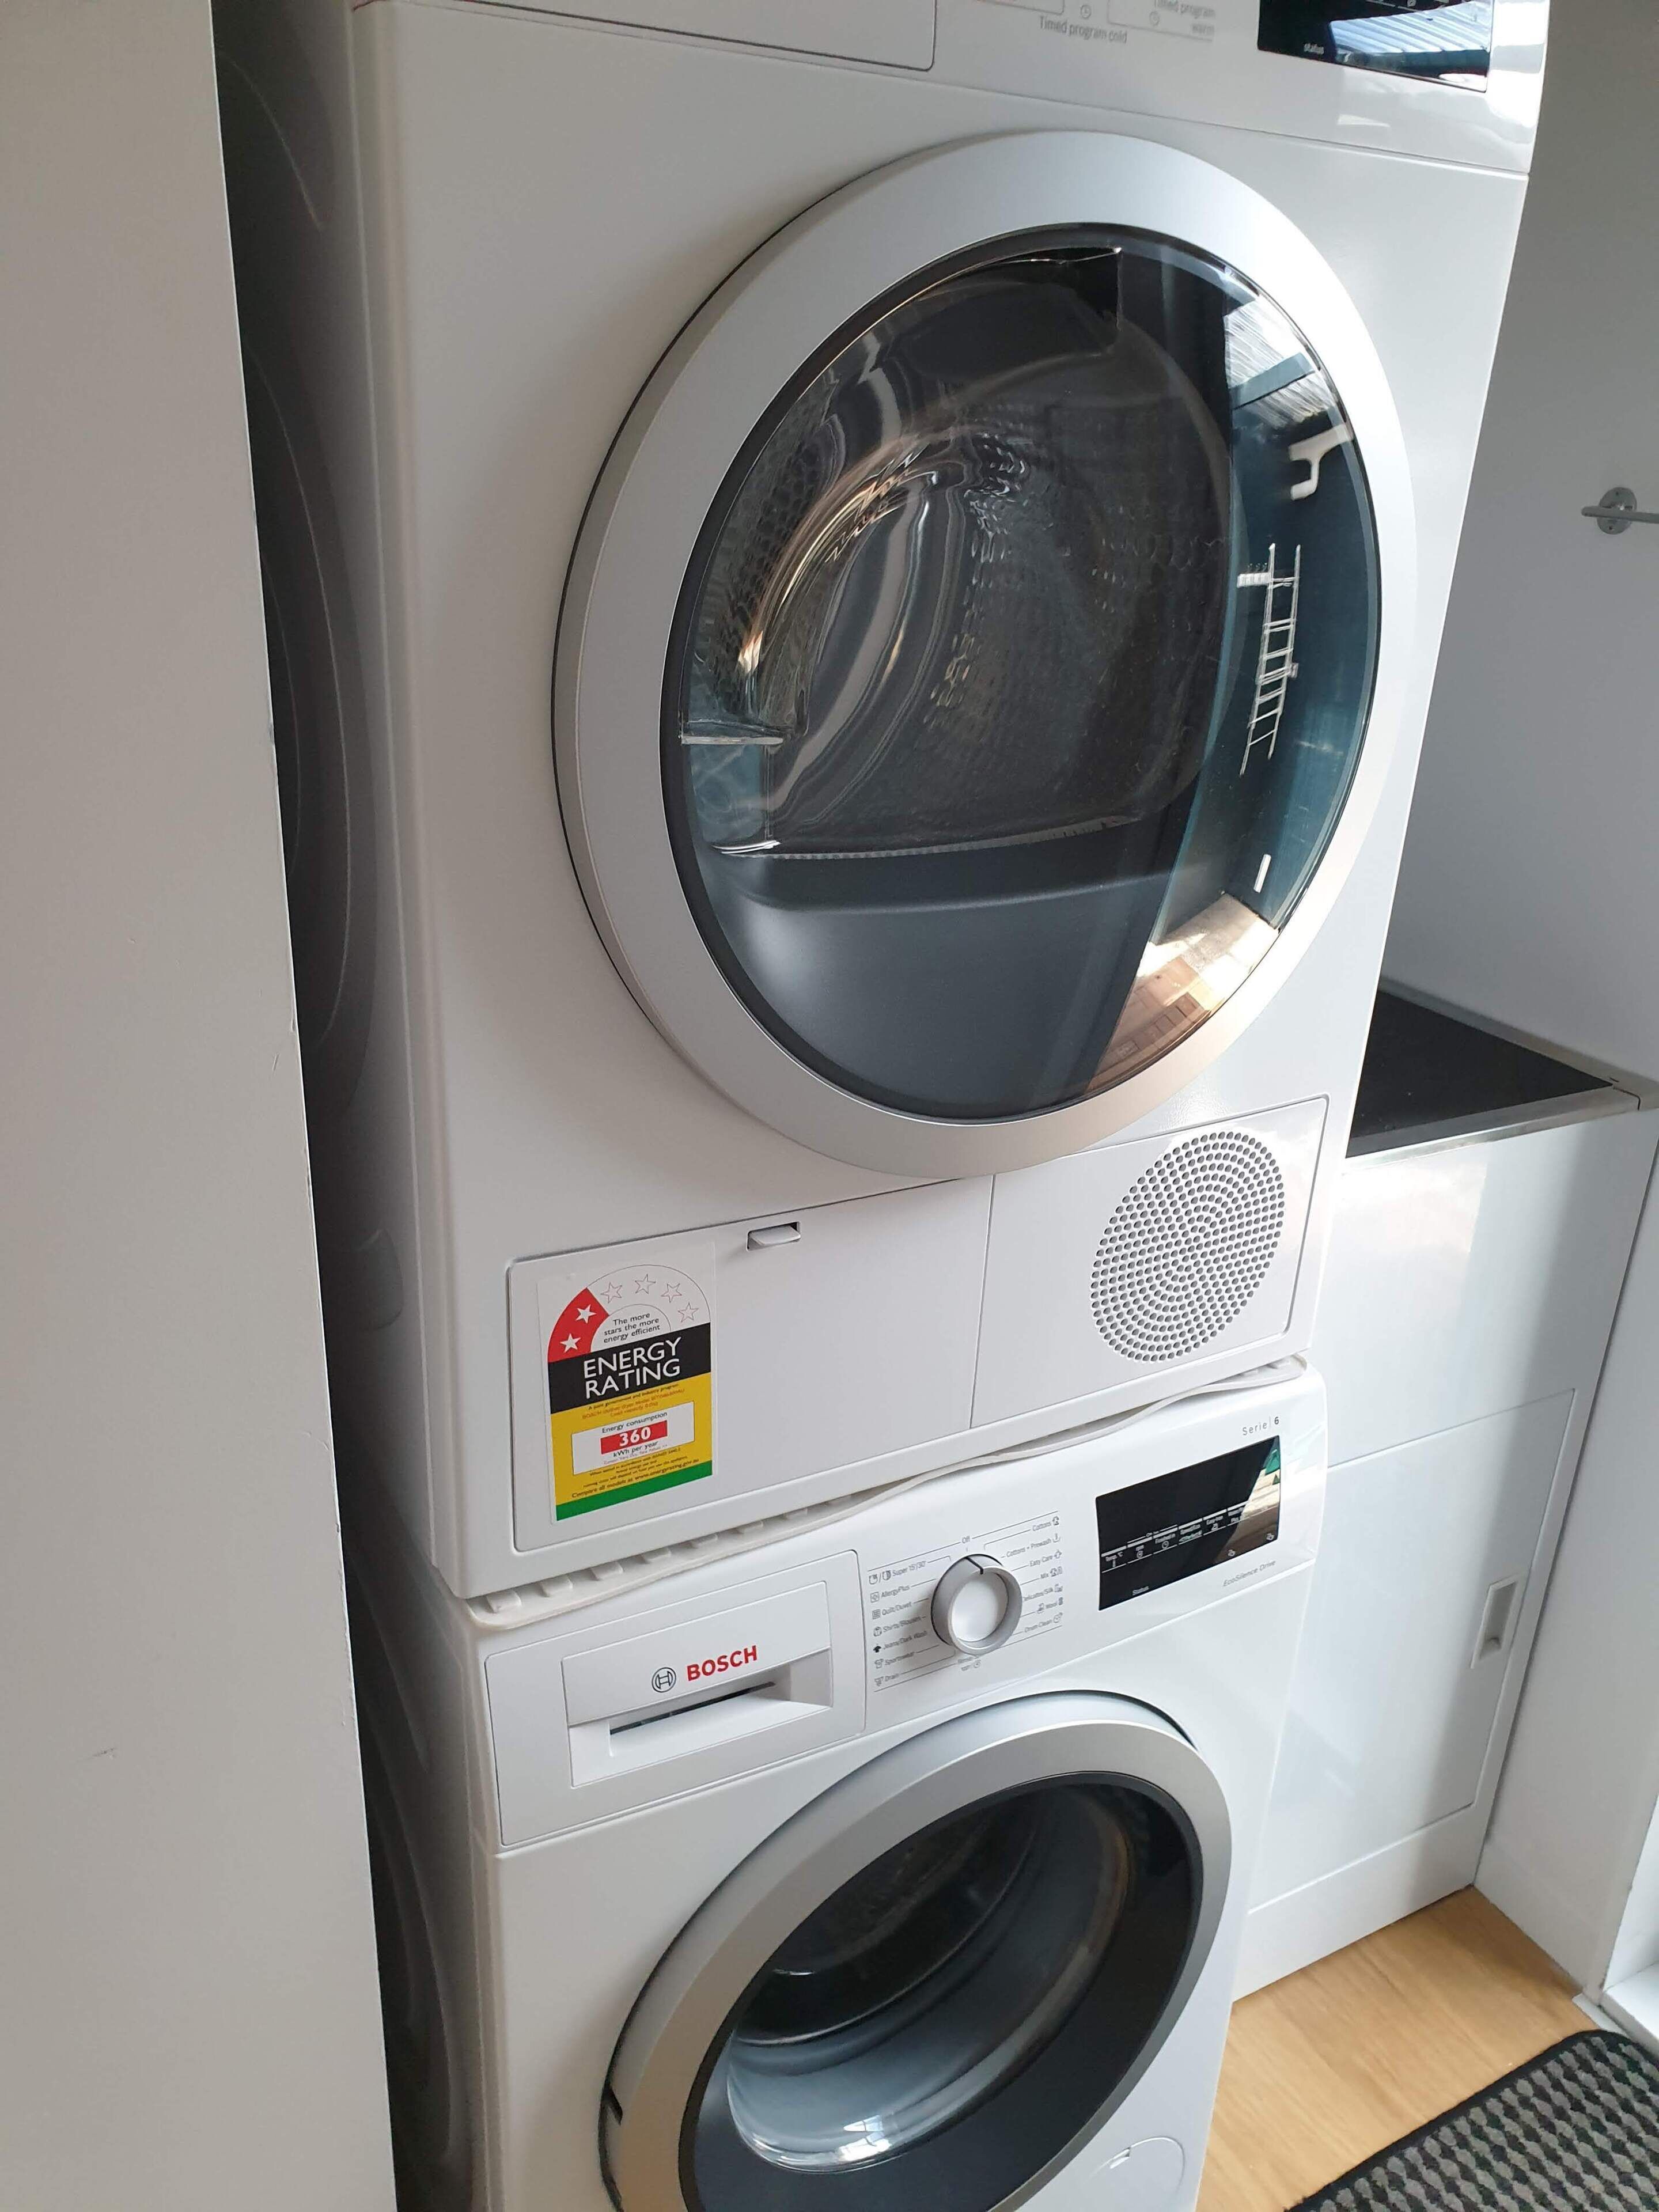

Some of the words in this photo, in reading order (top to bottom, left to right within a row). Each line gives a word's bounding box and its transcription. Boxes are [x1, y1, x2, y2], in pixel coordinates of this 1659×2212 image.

[1039, 15, 1067, 33] Timed
[1069, 24, 1107, 40] program
[604, 1327, 622, 1335] stars
[639, 1318, 660, 1327] more
[630, 1313, 650, 1322] more
[604, 1333, 628, 1343] energy
[631, 1324, 661, 1336] efficient
[583, 1336, 683, 1379] ENERGY
[585, 1358, 681, 1400] RATING
[602, 1423, 624, 1434] Energy
[626, 1411, 668, 1427] consumption
[1242, 1422, 1268, 1436] Serie
[1274, 1416, 1279, 1425] 6
[619, 1426, 652, 1447] 360
[613, 1448, 630, 1457] kWh
[631, 1445, 642, 1455] per
[645, 1441, 659, 1450] year
[571, 1488, 597, 1498] Compare
[607, 1479, 626, 1489] models
[1032, 1521, 1052, 1531] Cottons
[961, 1535, 971, 1544] Off
[1006, 1547, 1026, 1557] Cottons
[1031, 1538, 1052, 1548] Prewash
[892, 1567, 908, 1577] Super
[1223, 1568, 1258, 1586] EcoSilence
[1259, 1560, 1277, 1571] Drive
[685, 1645, 758, 1681] BOSCH
